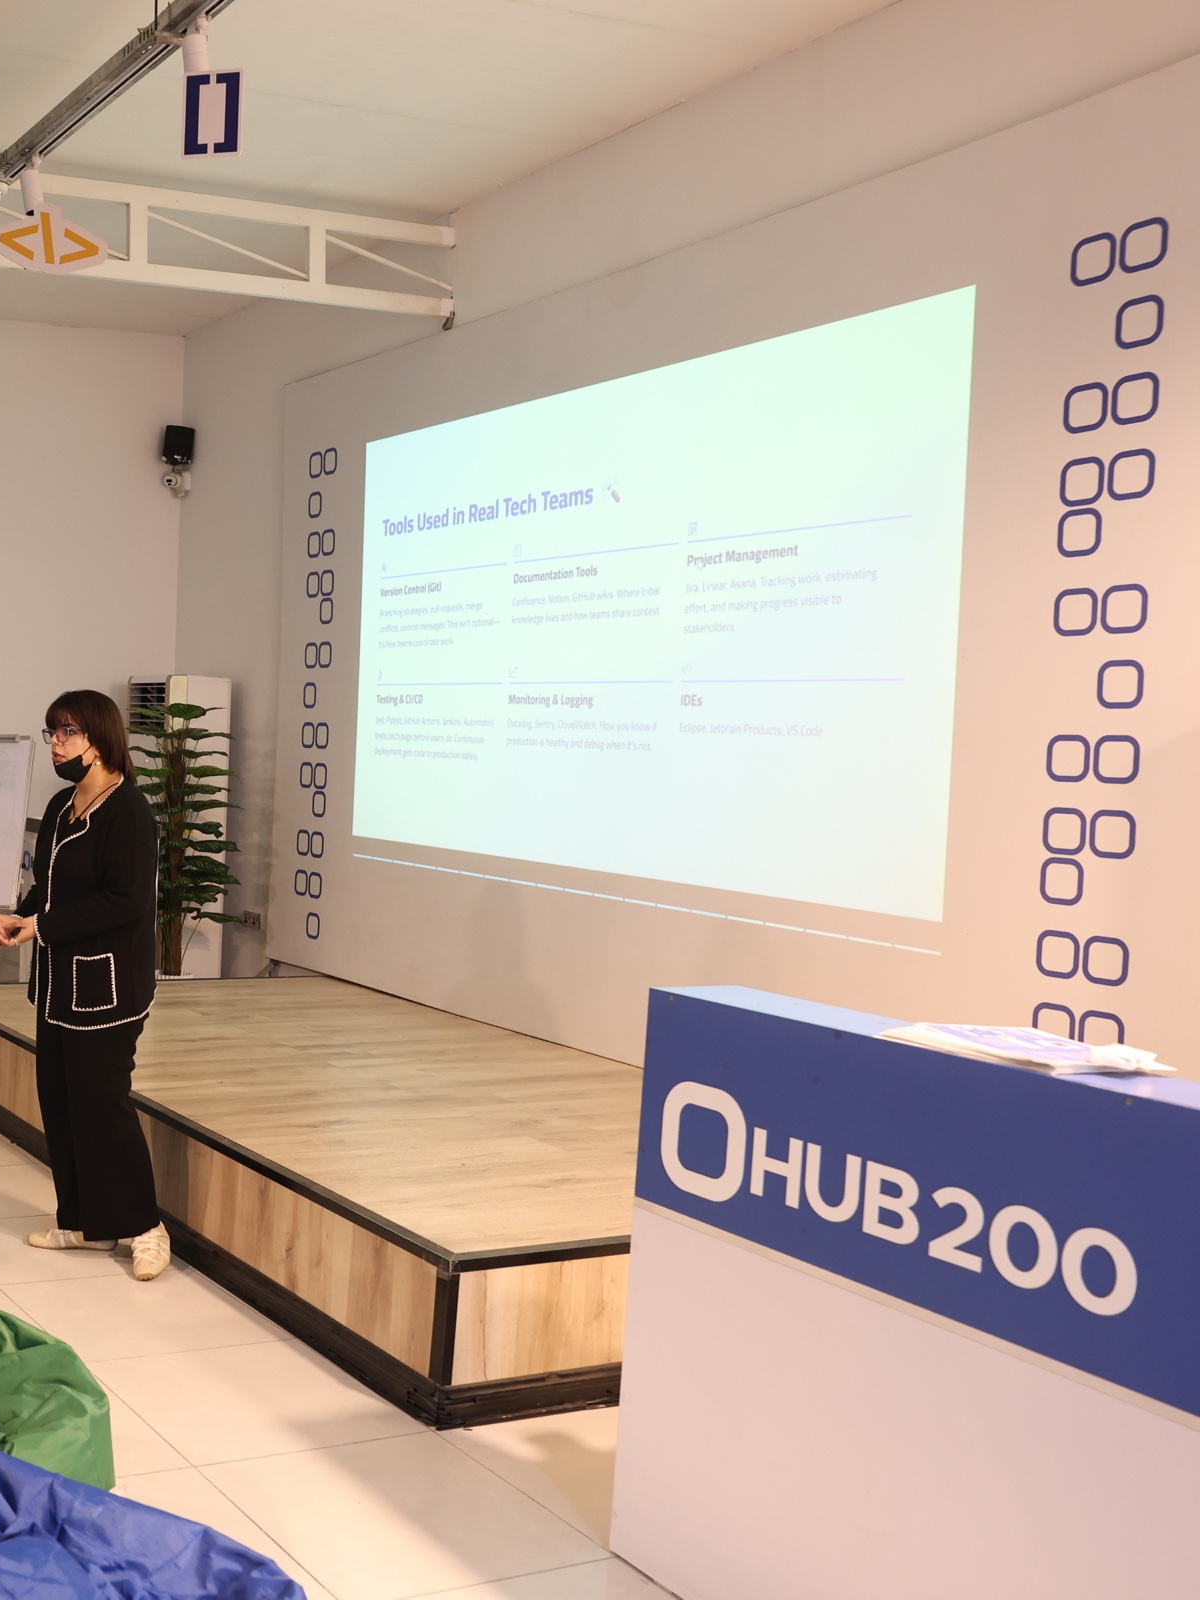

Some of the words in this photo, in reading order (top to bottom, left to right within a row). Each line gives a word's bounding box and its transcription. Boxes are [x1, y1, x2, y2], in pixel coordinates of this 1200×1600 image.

[383, 516, 414, 537] Tools
[417, 508, 449, 531] Used
[453, 507, 465, 526] in
[469, 499, 499, 523] Real
[503, 494, 537, 518] Tech
[541, 486, 593, 513] Teams
[725, 544, 799, 564] Management
[514, 568, 573, 584] Documentation
[576, 565, 598, 577] Tools
[685, 583, 700, 594] Jira,
[702, 581, 728, 592] Linear,
[730, 579, 758, 590] Asana.
[760, 575, 796, 588] Tracking
[798, 572, 823, 584] work,
[825, 568, 878, 583] estimating
[381, 587, 402, 597] Version
[404, 583, 426, 595] Control
[428, 581, 441, 594] (Git)
[512, 596, 546, 607] Confluence,
[548, 593, 570, 604] Notion,
[572, 592, 595, 602] GitHub
[596, 590, 614, 600] wikis.
[616, 588, 639, 598] Where
[641, 586, 660, 596] tribal
[710, 602, 726, 612] and
[727, 599, 758, 612] making
[759, 597, 798, 611] progress
[800, 594, 830, 606] visible
[831, 594, 842, 604] to
[380, 608, 402, 618] Branching
[430, 605, 439, 614] pull
[466, 602, 483, 613] merge
[512, 614, 544, 625] knowledge
[545, 613, 559, 622] lives
[560, 612, 573, 621] and
[574, 611, 588, 620] how
[589, 610, 610, 619] teams
[612, 609, 631, 618] share
[633, 606, 662, 617] context.
[400, 623, 419, 632] commit
[447, 620, 458, 628] This
[683, 621, 737, 634] stakeholders.
[413, 638, 440, 647] coordinate
[377, 694, 398, 706] Testing
[399, 695, 404, 704] &
[405, 694, 423, 704] CI/CD
[508, 694, 550, 708] Monitoring
[552, 696, 559, 705] &
[561, 695, 594, 708] Logging
[681, 694, 703, 706] IDEs
[404, 717, 421, 725] GitHub
[464, 718, 494, 727] Automated
[507, 719, 533, 730] Datadog,
[535, 719, 556, 730] Sentry,
[557, 720, 597, 730] CloudWatch.
[599, 721, 615, 731] How
[617, 723, 630, 733] you
[631, 722, 650, 731] know
[652, 722, 658, 731] if
[680, 722, 707, 734] Eclipse,
[710, 724, 742, 734] Jetbrain
[743, 724, 784, 736] Products,
[786, 725, 798, 736] VS
[800, 725, 824, 737] Code
[375, 732, 386, 740] tests
[401, 734, 412, 743] bugs
[413, 733, 429, 742] before
[445, 735, 453, 743] do.
[454, 734, 485, 744] Continuous
[507, 738, 538, 747] production
[540, 738, 544, 746] is
[545, 739, 569, 749] healthy
[570, 740, 583, 748] and
[584, 740, 604, 751] debug
[606, 741, 625, 750] when
[626, 742, 637, 751] it's
[638, 743, 652, 751] not.
[374, 747, 402, 757] deployment
[402, 750, 413, 758] gets
[427, 750, 432, 758] to
[433, 750, 460, 759] production
